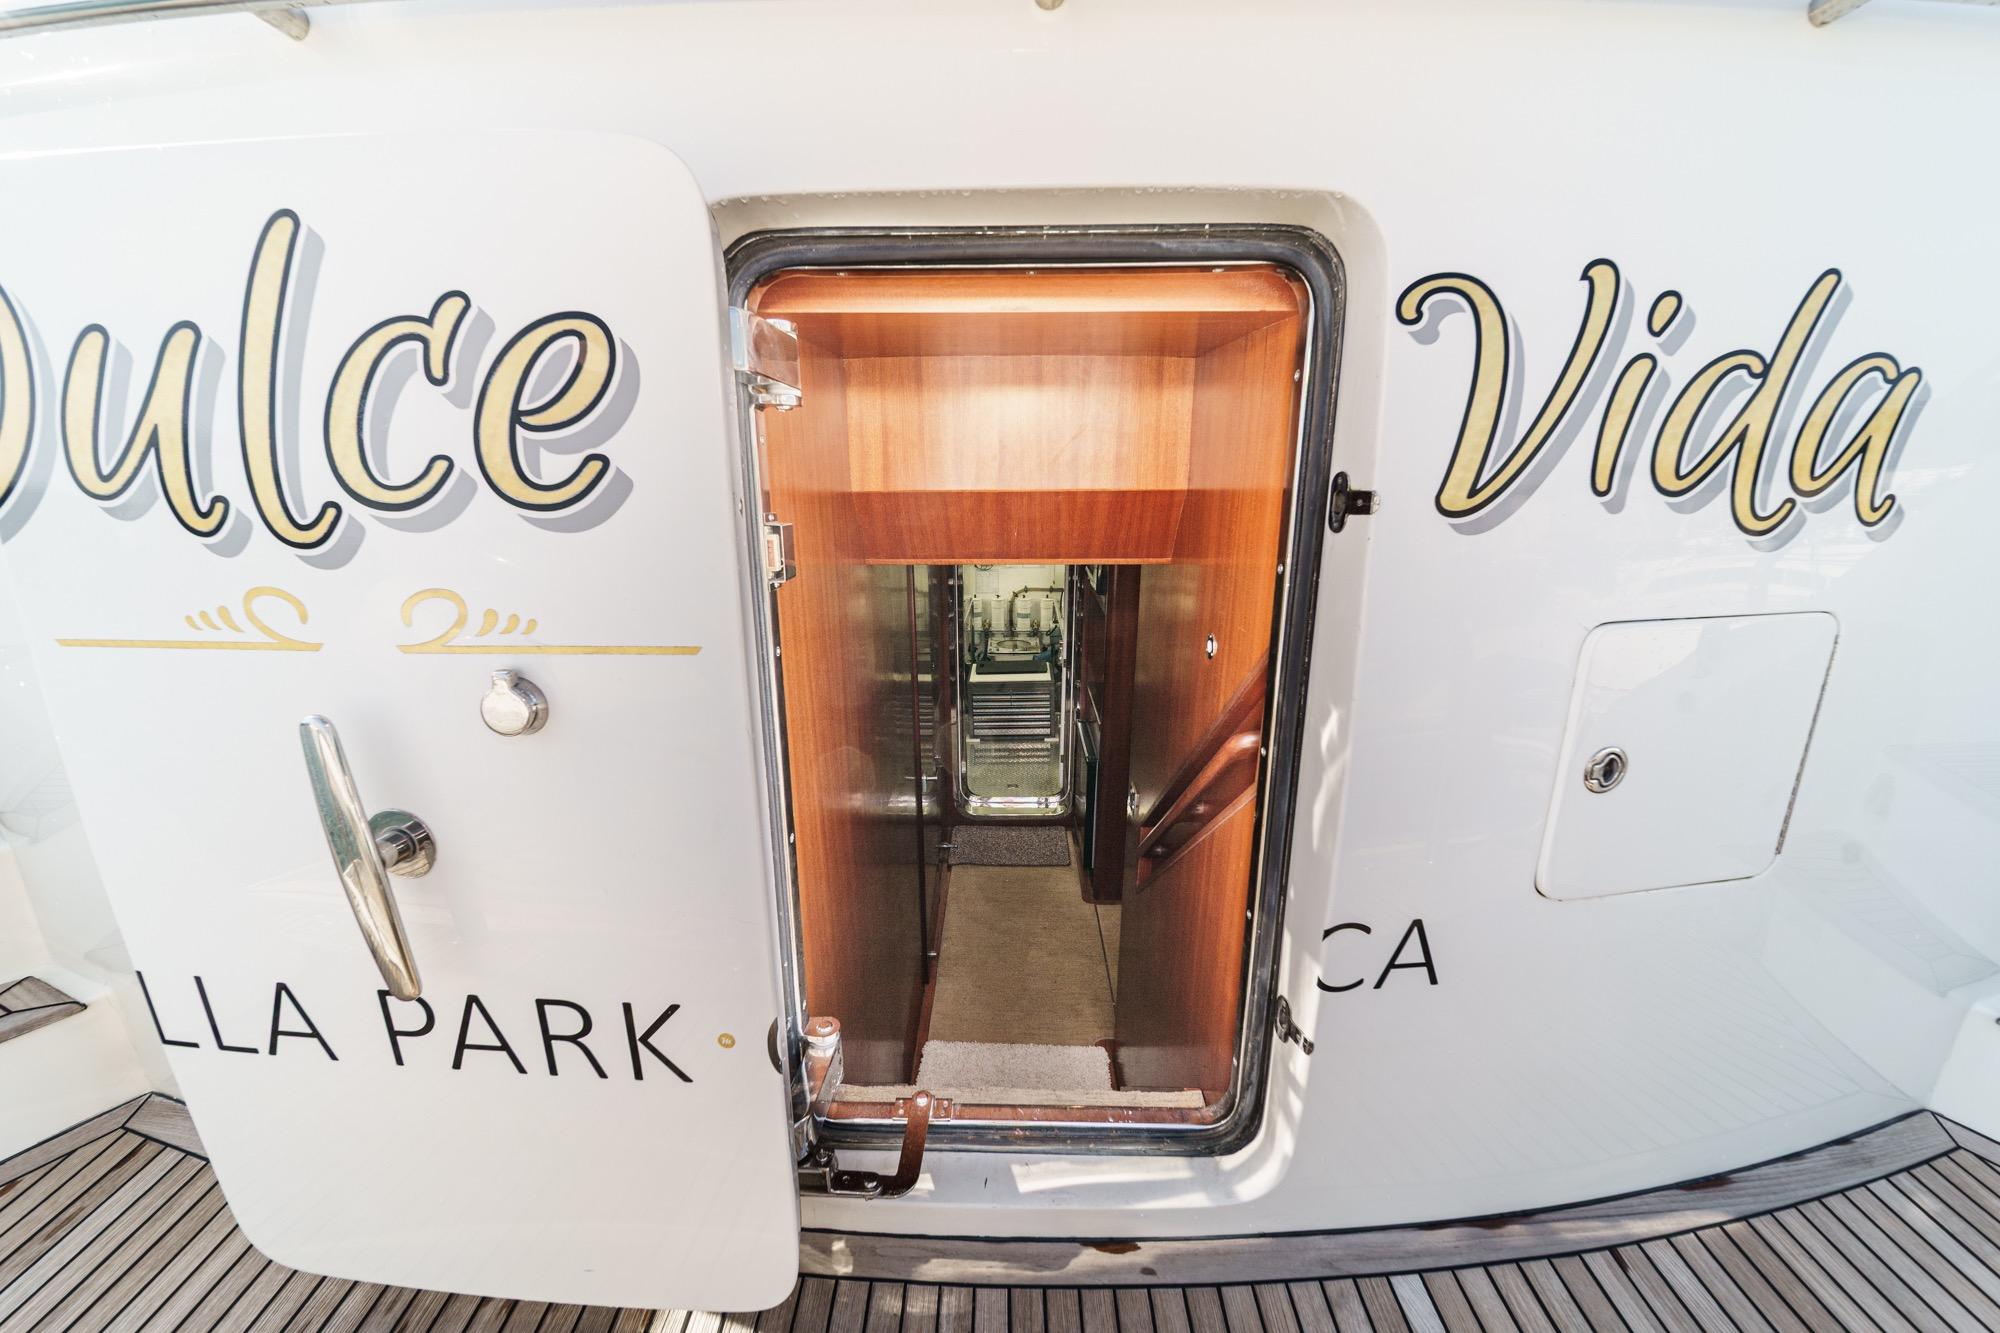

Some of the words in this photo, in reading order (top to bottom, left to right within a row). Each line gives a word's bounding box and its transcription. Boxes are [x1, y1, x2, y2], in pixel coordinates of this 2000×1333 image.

[0, 208, 617, 550] ulce
[1395, 257, 1923, 537] Vida
[136, 970, 339, 1061] LLA
[376, 988, 694, 1083] PARK
